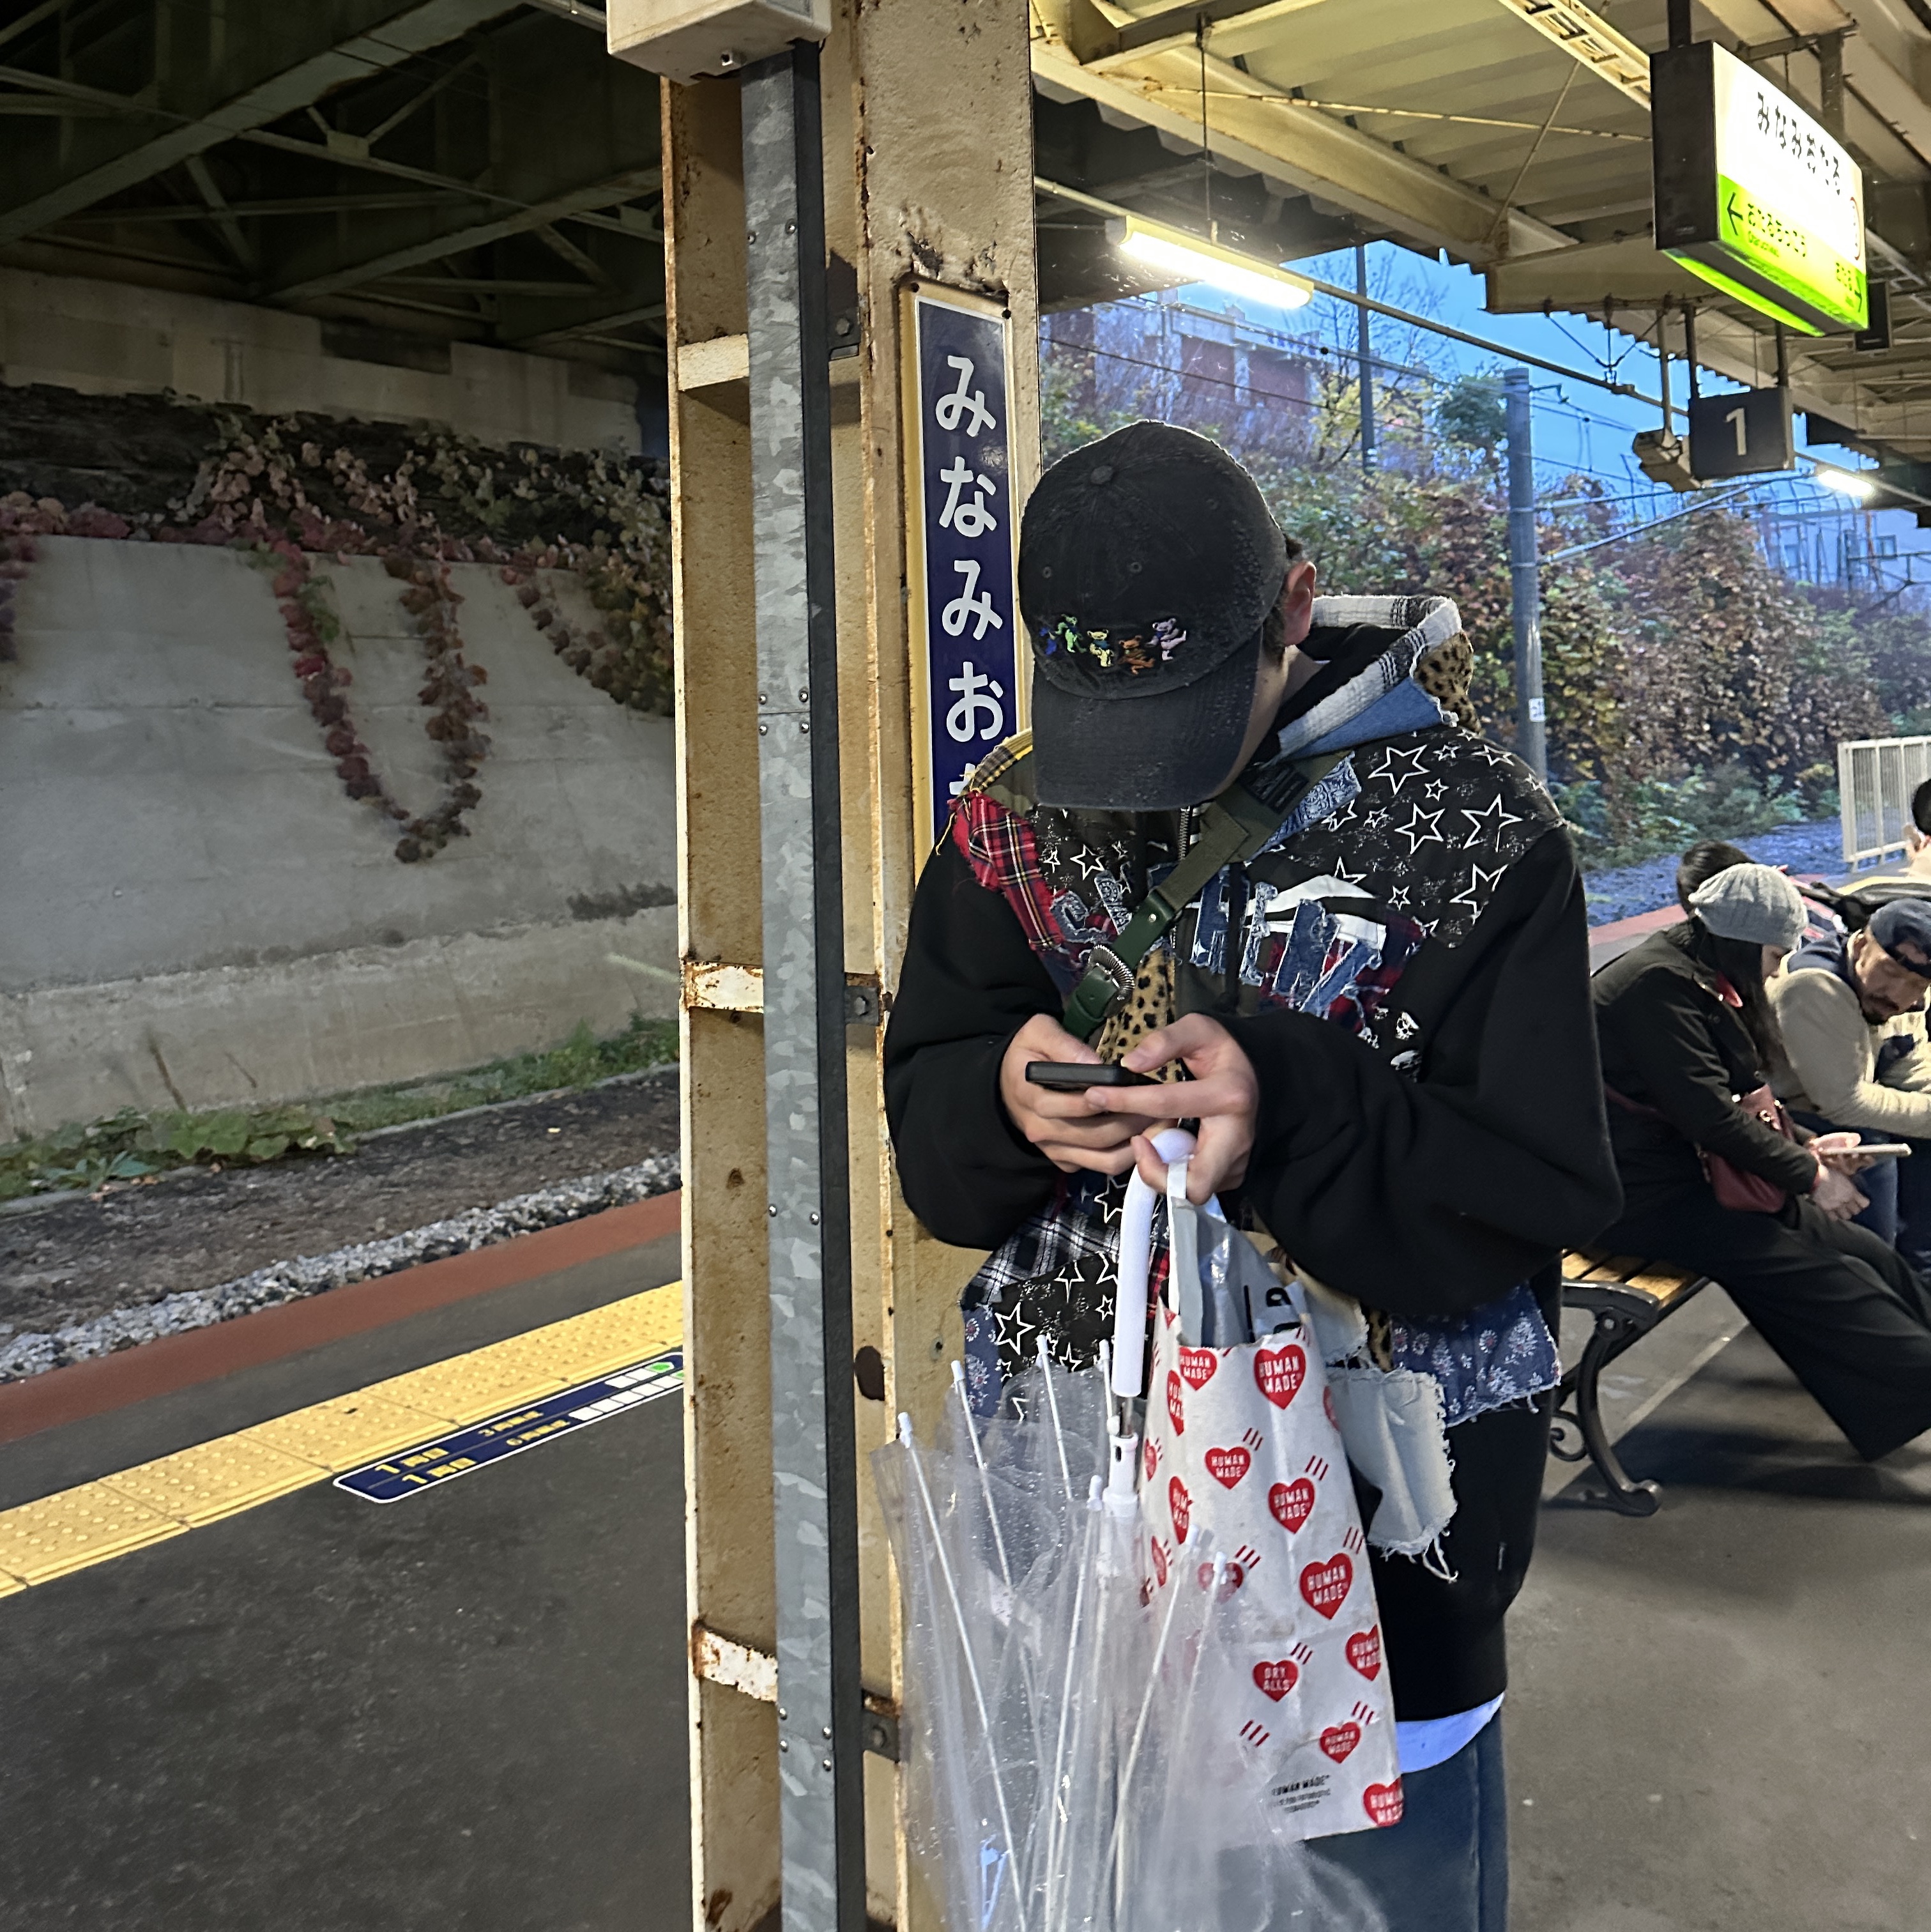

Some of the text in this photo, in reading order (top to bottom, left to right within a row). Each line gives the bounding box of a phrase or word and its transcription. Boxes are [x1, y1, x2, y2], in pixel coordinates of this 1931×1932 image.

[1725, 407, 1747, 456] 1
[1183, 1367, 1208, 1381] MADE
[1258, 1355, 1300, 1379] HUMAN
[1263, 1374, 1298, 1393] MADE
[1211, 1454, 1245, 1468] HUMAN
[1215, 1466, 1243, 1478] MADE
[1274, 1487, 1309, 1508] HUMAN
[1278, 1503, 1307, 1521] MADE
[1307, 1564, 1346, 1591] HUMAN
[1312, 1583, 1344, 1606] MADE
